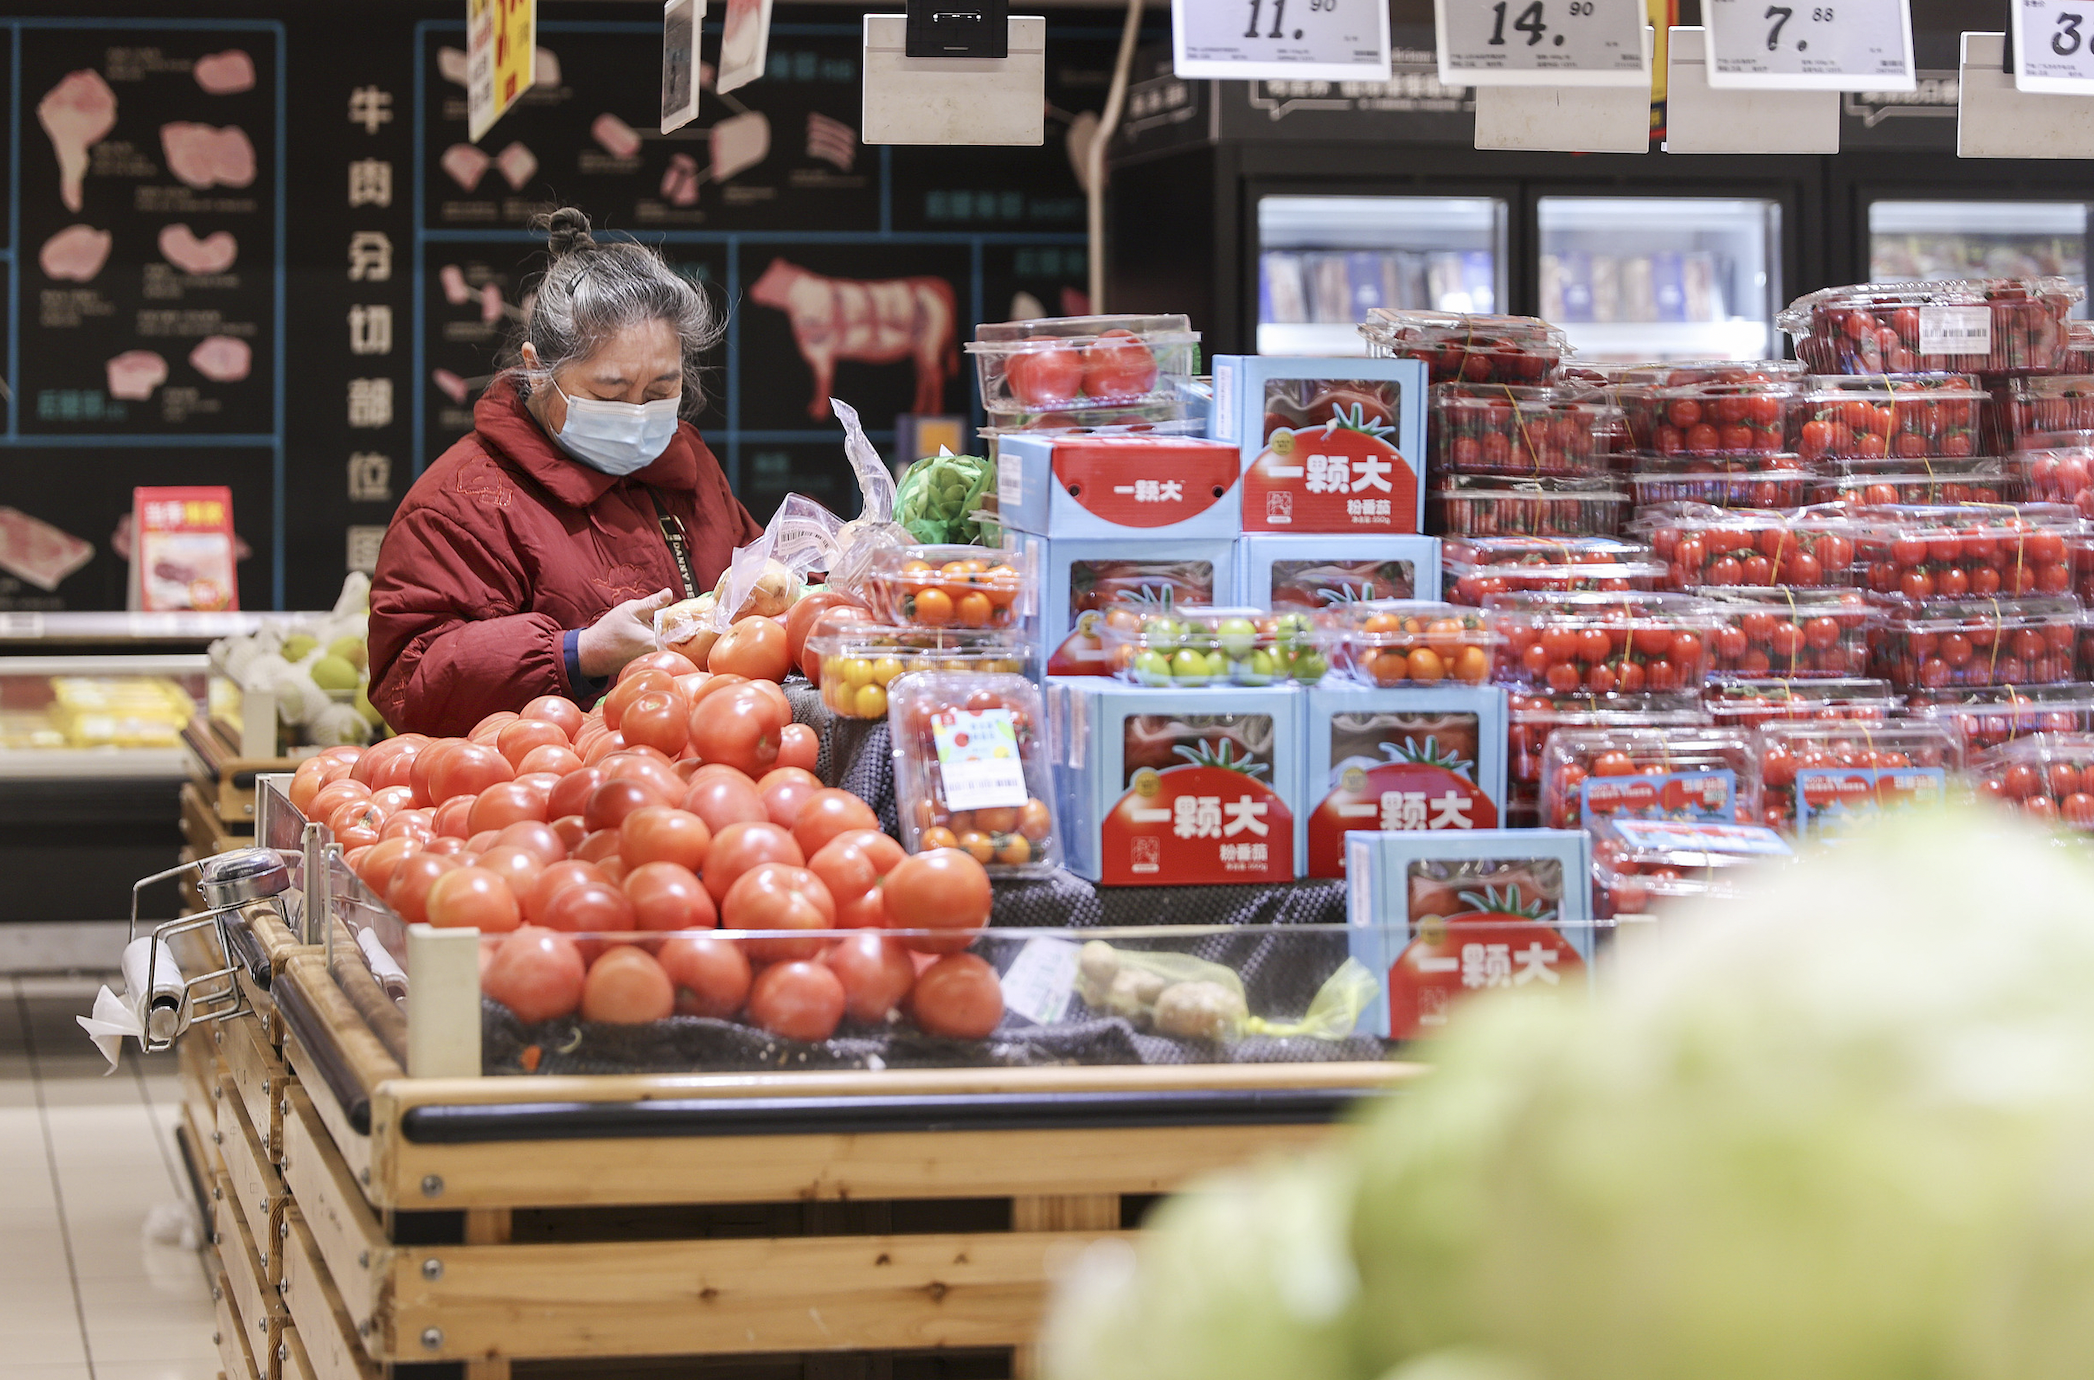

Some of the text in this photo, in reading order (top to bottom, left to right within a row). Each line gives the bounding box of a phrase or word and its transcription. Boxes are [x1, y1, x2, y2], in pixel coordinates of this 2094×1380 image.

[2051, 11, 2094, 57] 3
[1113, 479, 1183, 502] 一颗大
[1267, 454, 1393, 495] 一颗大
[1346, 498, 1392, 516] 粉番茄
[673, 542, 690, 581] DANNY
[1131, 794, 1270, 840] 一颗大
[1337, 789, 1474, 831] 一颗大
[1219, 843, 1269, 862] 粉番茄
[1416, 941, 1561, 988] 一颗大
